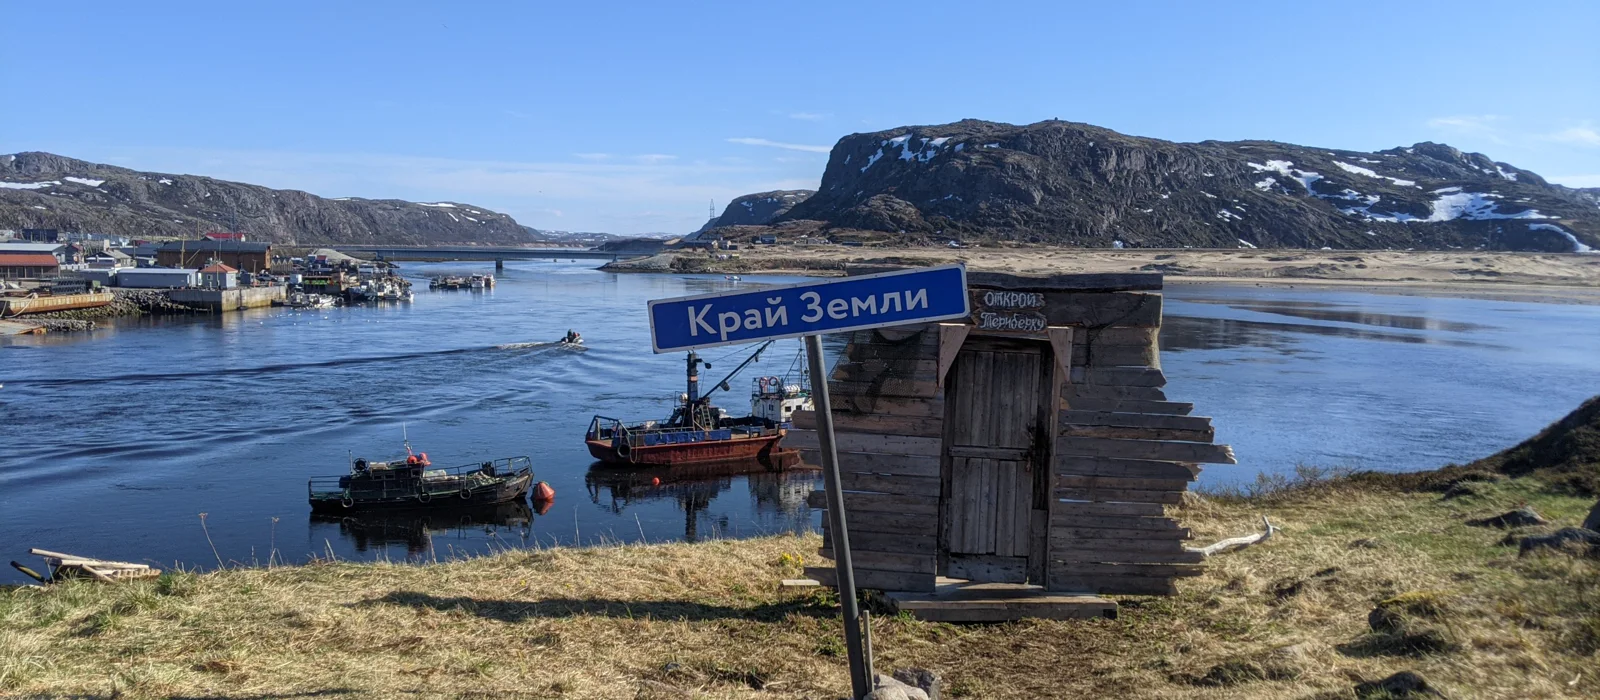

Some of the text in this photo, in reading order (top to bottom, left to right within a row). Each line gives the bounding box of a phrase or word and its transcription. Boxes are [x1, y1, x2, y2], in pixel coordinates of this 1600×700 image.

[687, 288, 929, 341] Край Земли
[980, 312, 1044, 330] Териберку
